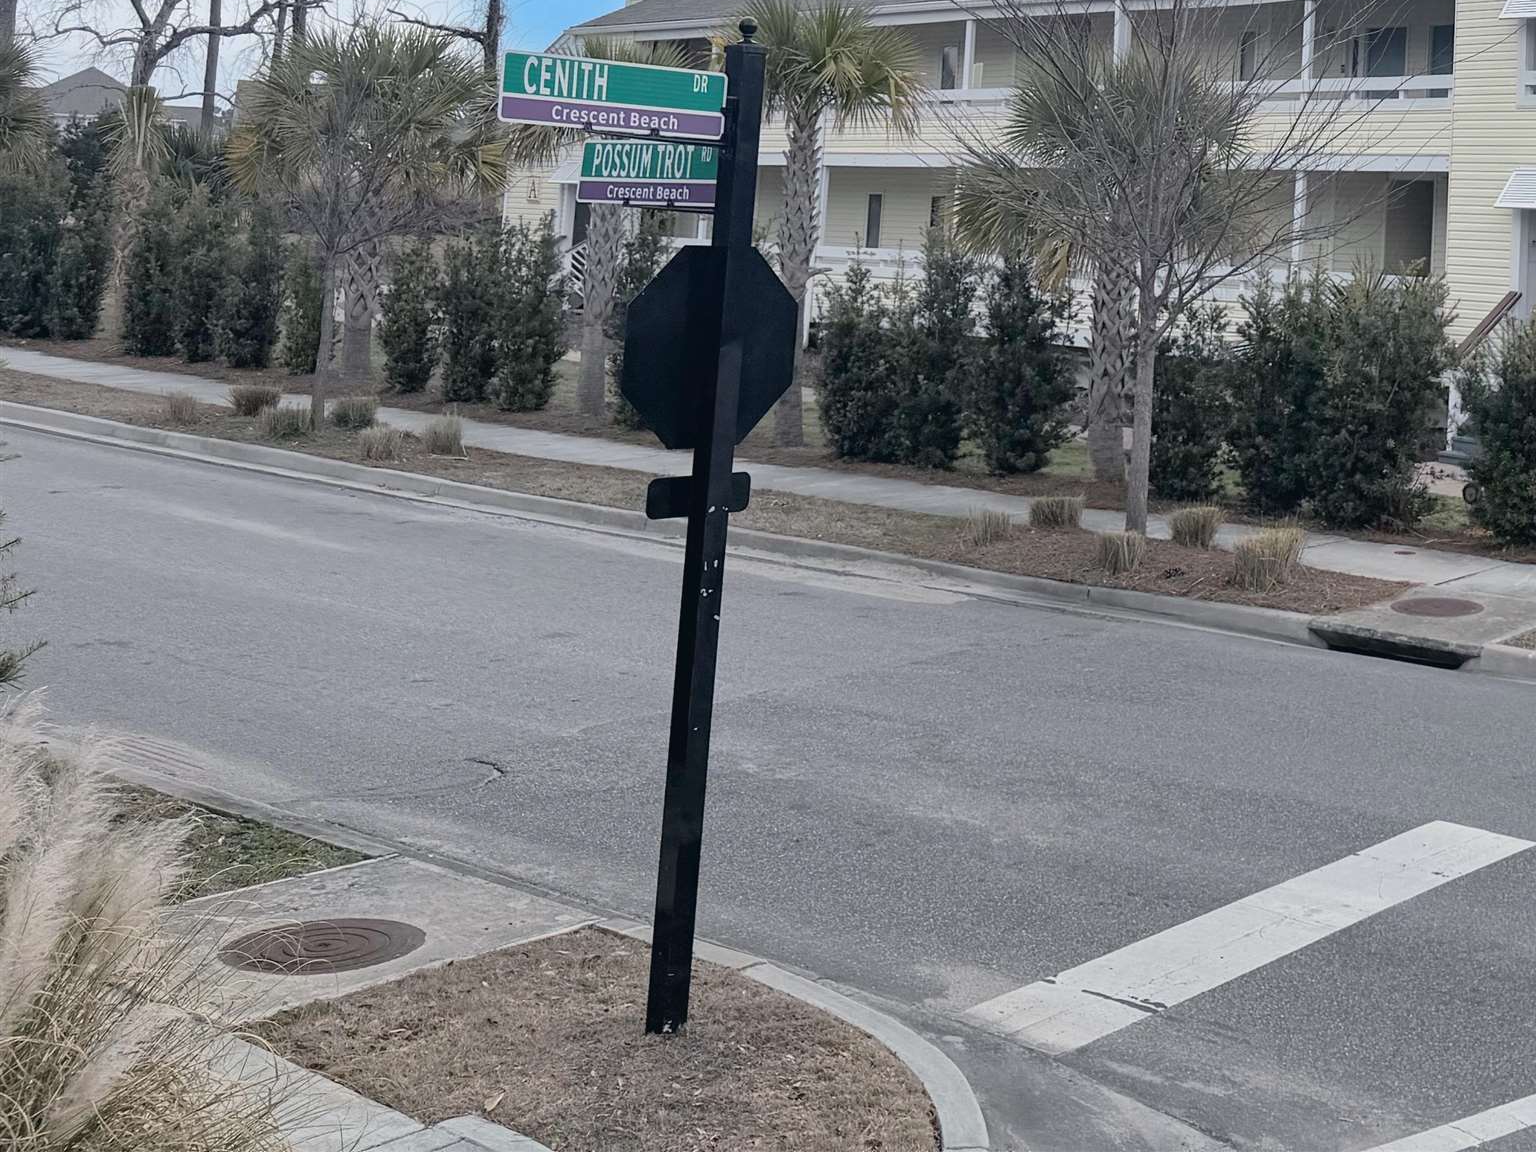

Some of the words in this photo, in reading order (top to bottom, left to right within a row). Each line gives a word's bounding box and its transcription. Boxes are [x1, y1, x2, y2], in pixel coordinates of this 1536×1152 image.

[523, 56, 609, 100] CENITH
[693, 74, 709, 93] DR
[551, 105, 625, 126] Crescent
[630, 112, 679, 131] Beach
[591, 144, 653, 178] POSSUM
[656, 144, 695, 178] TROT
[701, 146, 713, 162] RD
[607, 185, 654, 199] Crescent
[656, 186, 689, 200] Beach
